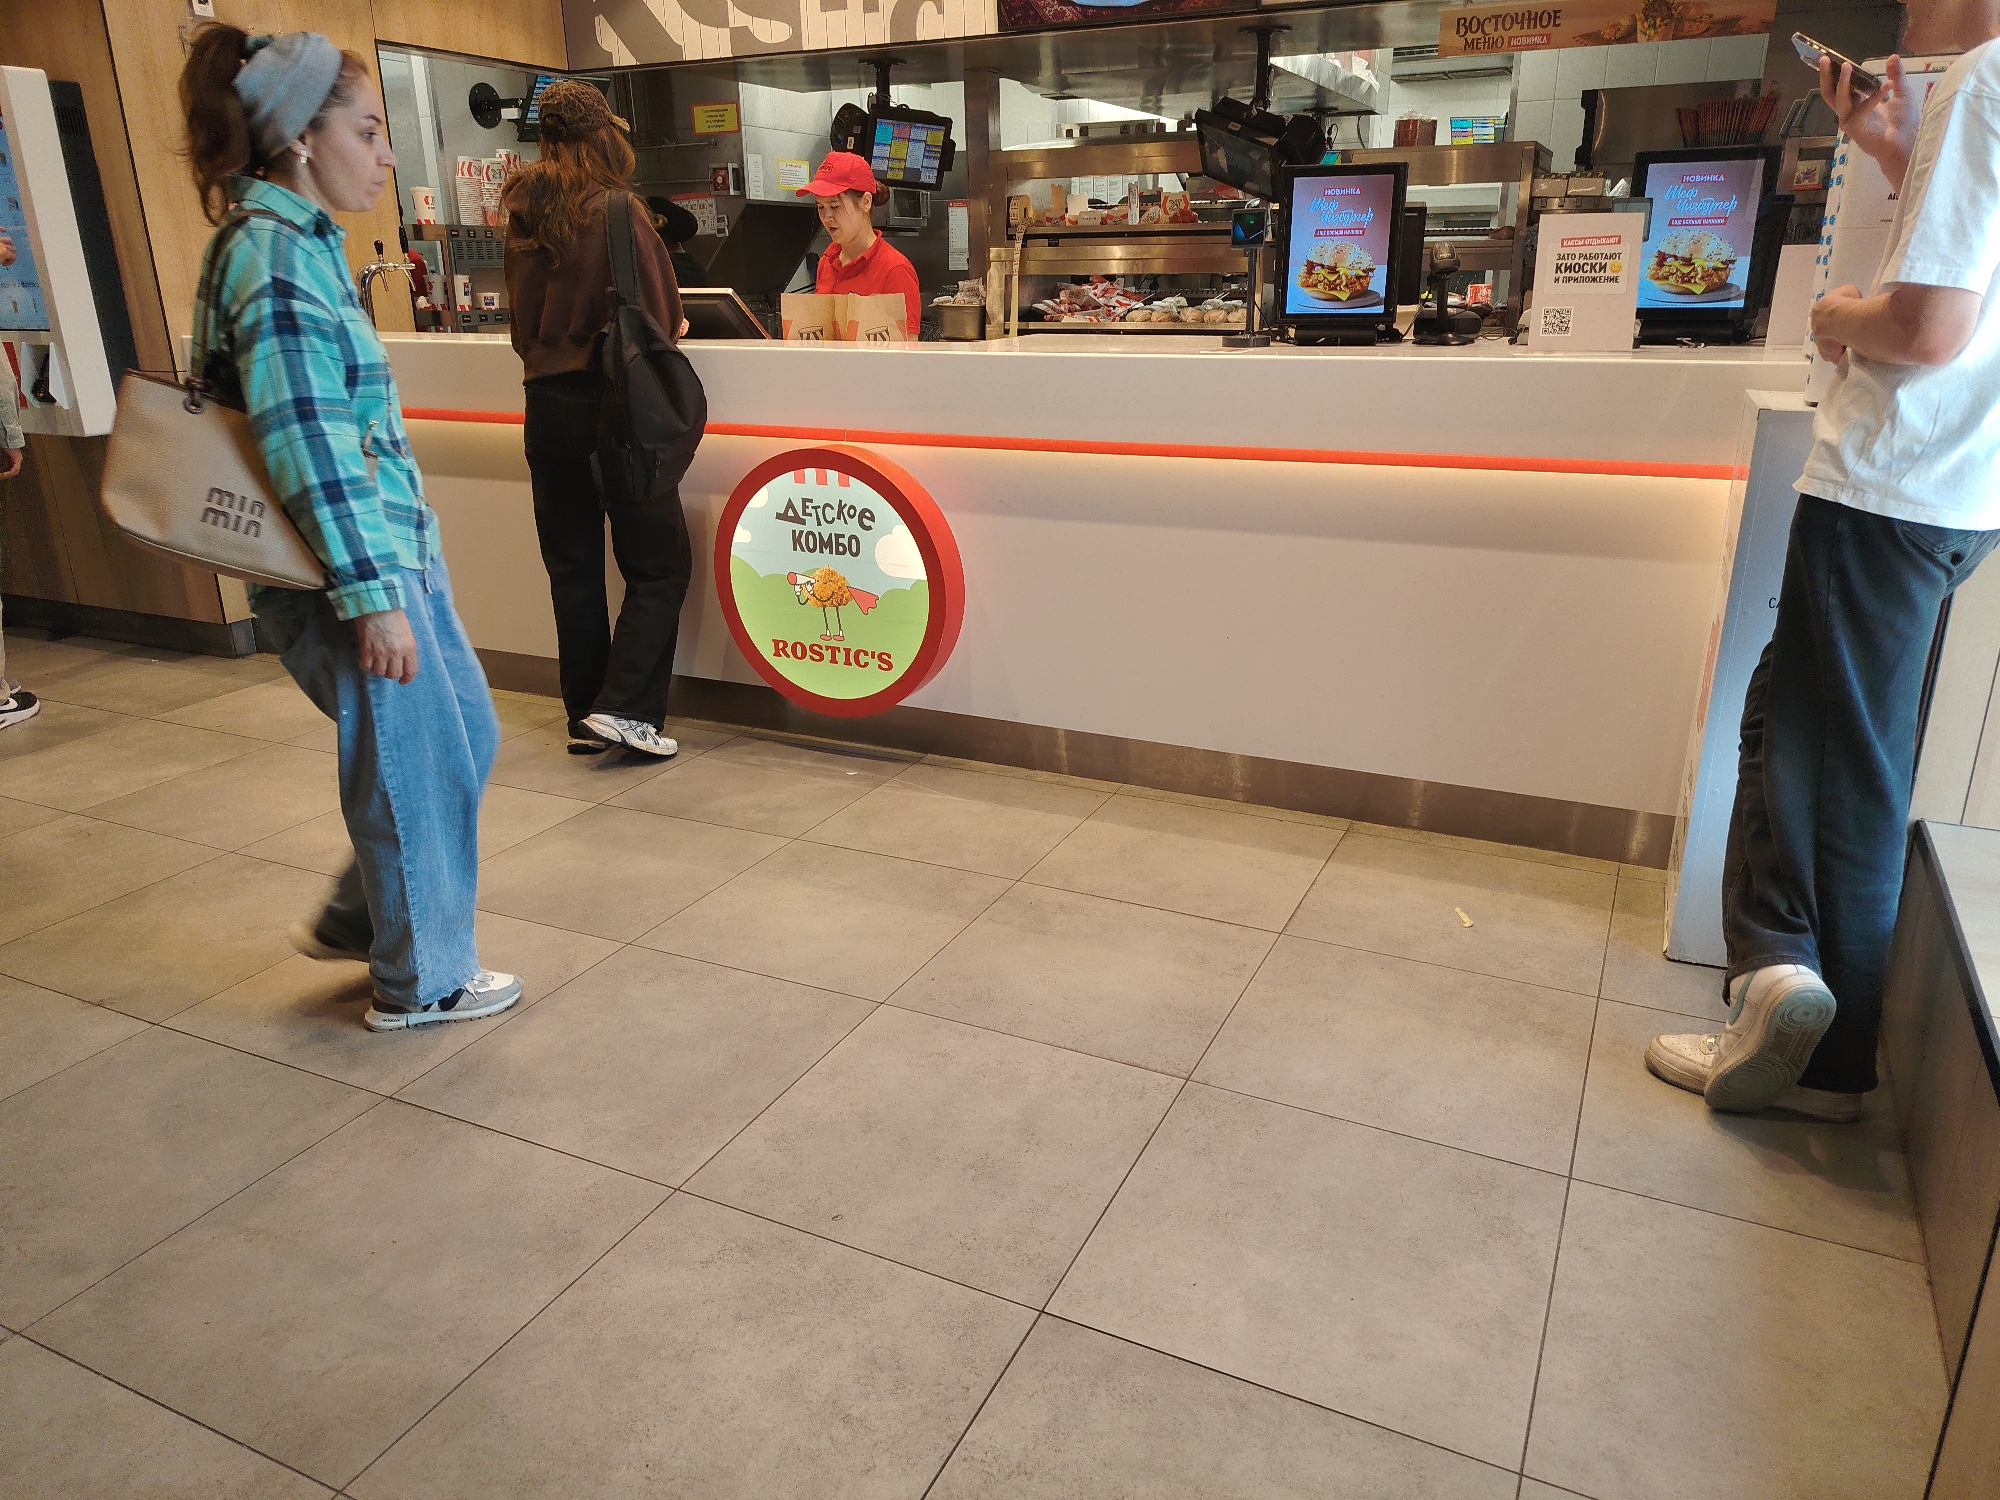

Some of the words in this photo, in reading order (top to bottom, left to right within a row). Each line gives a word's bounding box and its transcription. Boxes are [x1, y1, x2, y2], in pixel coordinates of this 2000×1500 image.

[1455, 9, 1562, 38] ВОСТОЧНОЕ
[1463, 35, 1505, 52] МЕНЮ
[1510, 36, 1548, 46] НОВИНКА
[1682, 174, 1725, 183] НОВИНКА
[1324, 187, 1361, 196] НОВИНКА
[1664, 184, 1698, 200] Шеф
[1309, 197, 1339, 213] Шеф
[1563, 239, 1585, 247] КАССЫ
[1585, 237, 1620, 246] ОТДЫХАЮТ
[1556, 253, 1577, 261] ЗАТО
[1578, 252, 1622, 261] РАБОТАЮТ
[1554, 261, 1608, 275] КИОСКИ
[1553, 276, 1560, 284] И
[1562, 275, 1620, 284] ПРИЛОЖЕНИЕ
[791, 529, 861, 558] КОМБО
[772, 638, 894, 672] ROSTIC'S
